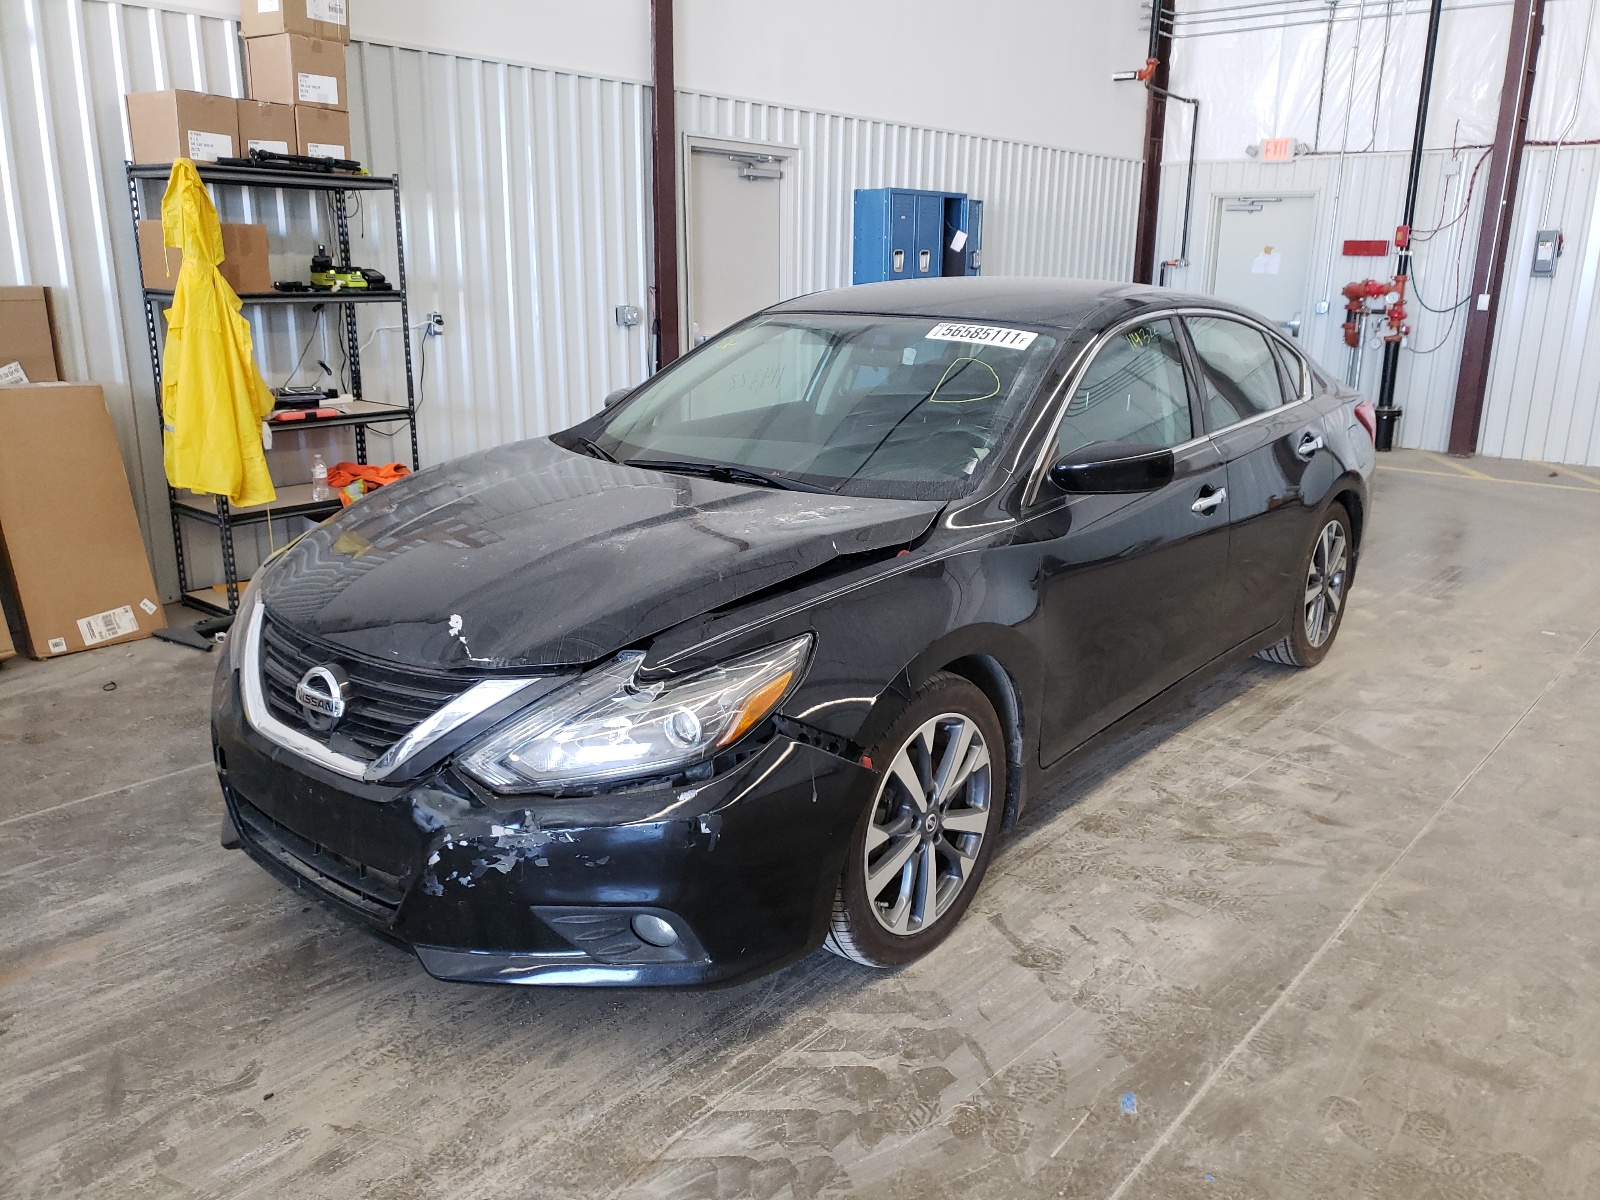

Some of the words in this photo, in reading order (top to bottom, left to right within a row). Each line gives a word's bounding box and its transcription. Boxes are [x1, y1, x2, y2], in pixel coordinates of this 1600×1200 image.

[1264, 138, 1291, 160] EXIT
[942, 324, 1021, 345] 56585111
[1018, 337, 1028, 345] F
[296, 690, 334, 712] NISSAN
